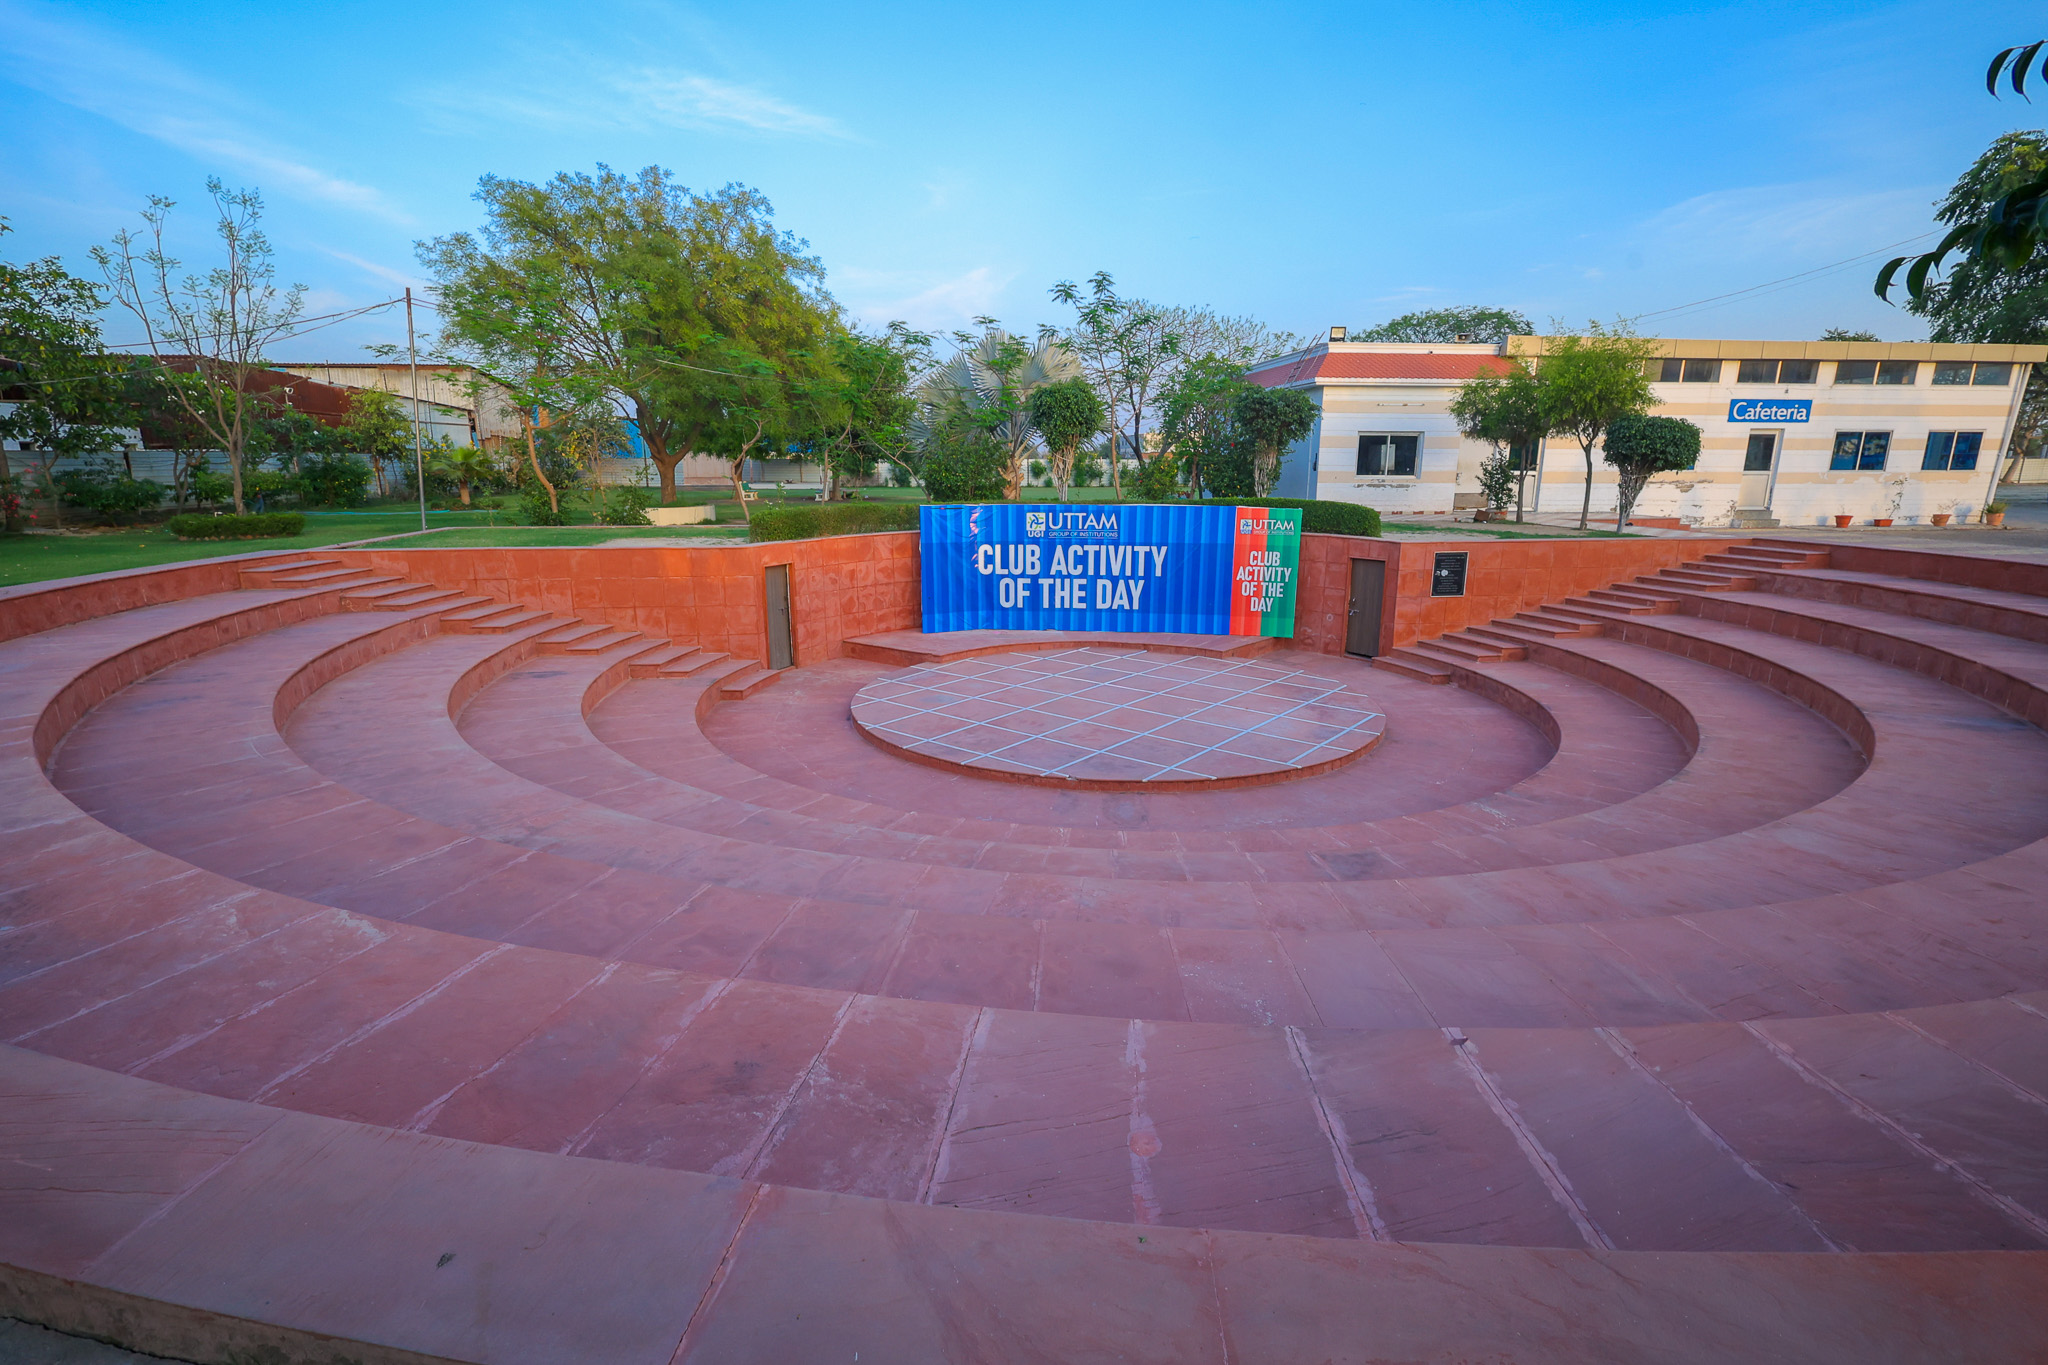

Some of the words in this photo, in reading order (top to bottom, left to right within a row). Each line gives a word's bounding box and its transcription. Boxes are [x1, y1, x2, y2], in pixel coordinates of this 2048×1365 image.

[1733, 402, 1807, 420] Cafeteria
[1049, 512, 1118, 530] UTTAM
[1253, 519, 1294, 530] UTTAM
[978, 544, 1041, 576] CLUB
[1050, 544, 1168, 577] ACTIVITY
[1249, 551, 1280, 566] CLUB
[1236, 566, 1292, 582] ACTIVITY
[999, 577, 1031, 609] OF
[1038, 578, 1088, 609] THE
[1096, 579, 1145, 610] DAY
[1241, 582, 1257, 596] OF
[1261, 582, 1284, 597] THE
[1250, 597, 1273, 612] DAY
